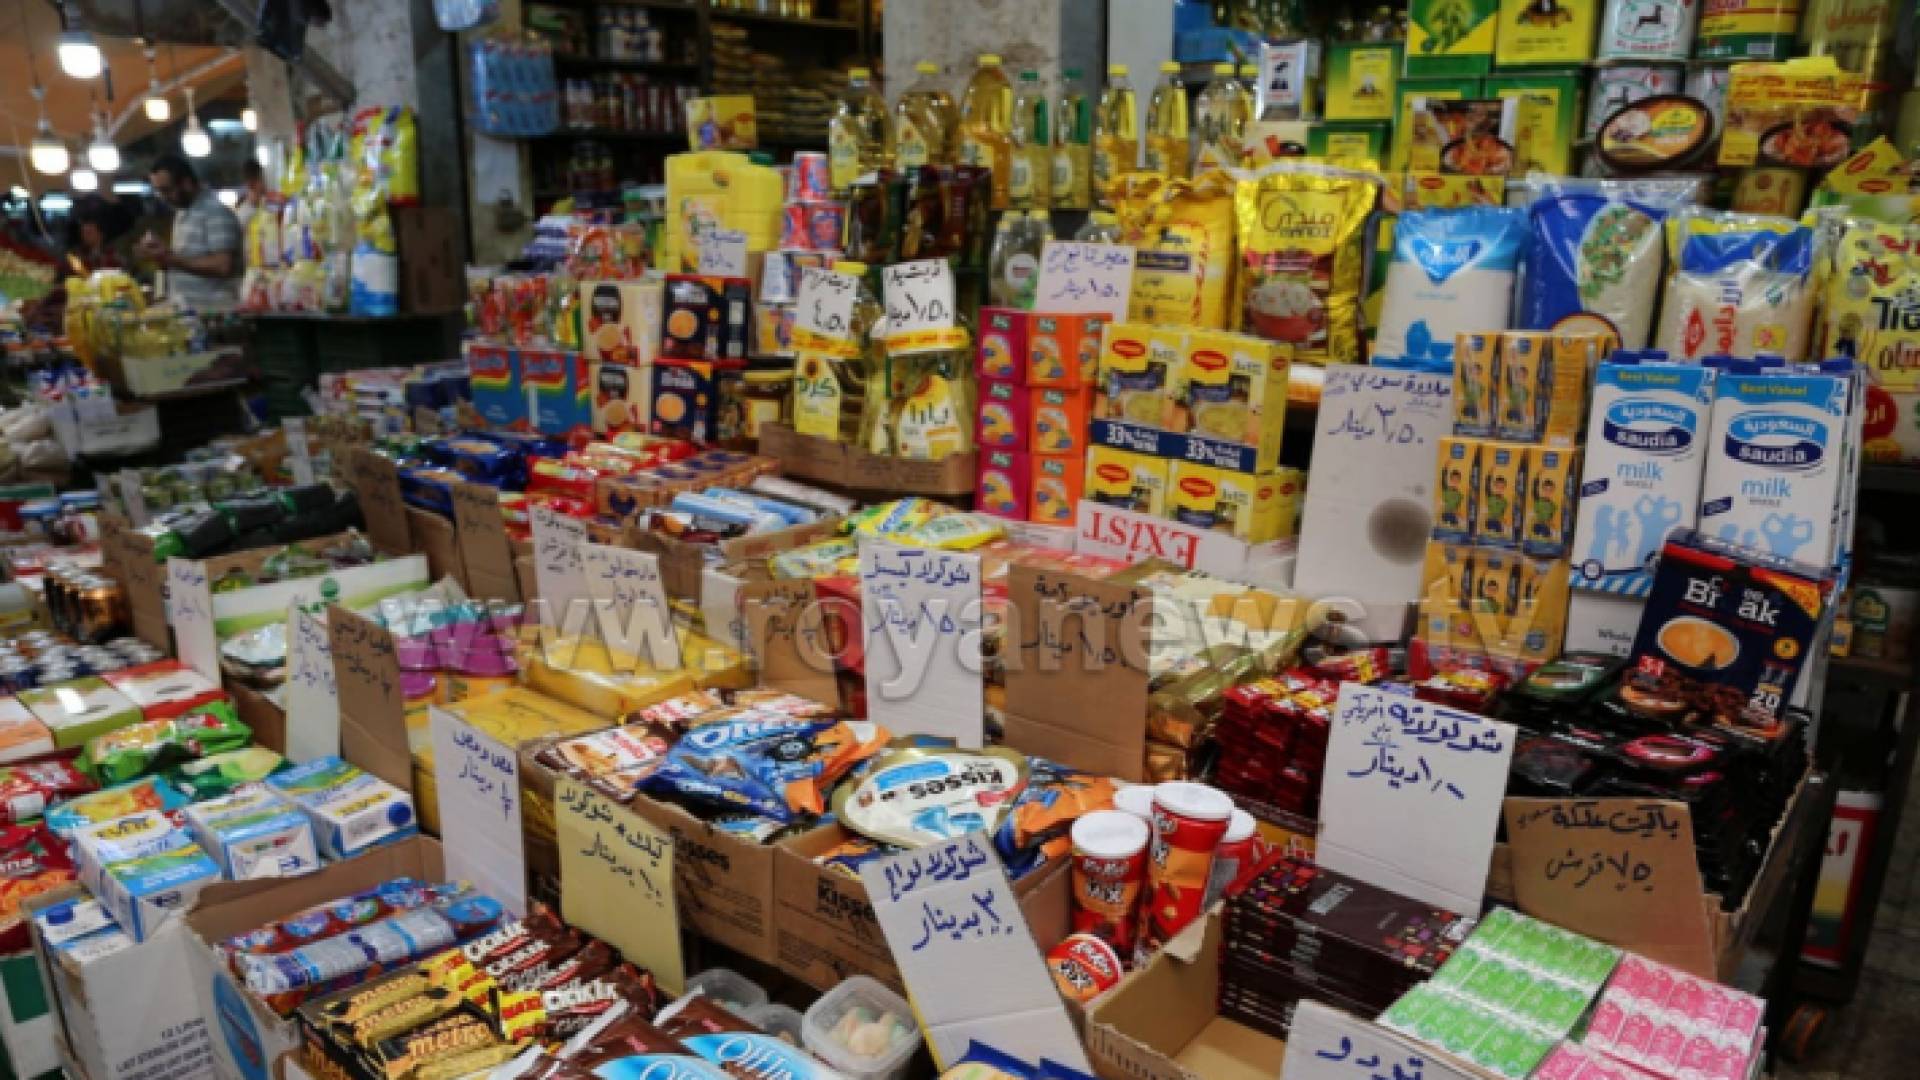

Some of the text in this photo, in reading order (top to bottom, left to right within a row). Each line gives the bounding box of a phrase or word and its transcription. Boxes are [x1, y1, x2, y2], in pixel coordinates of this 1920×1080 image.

[1327, 408, 1375, 440] دينار
[1617, 462, 1662, 483] milk
[1741, 478, 1790, 498] milk
[1346, 747, 1419, 789] دينار
[1545, 848, 1605, 889] قرش
